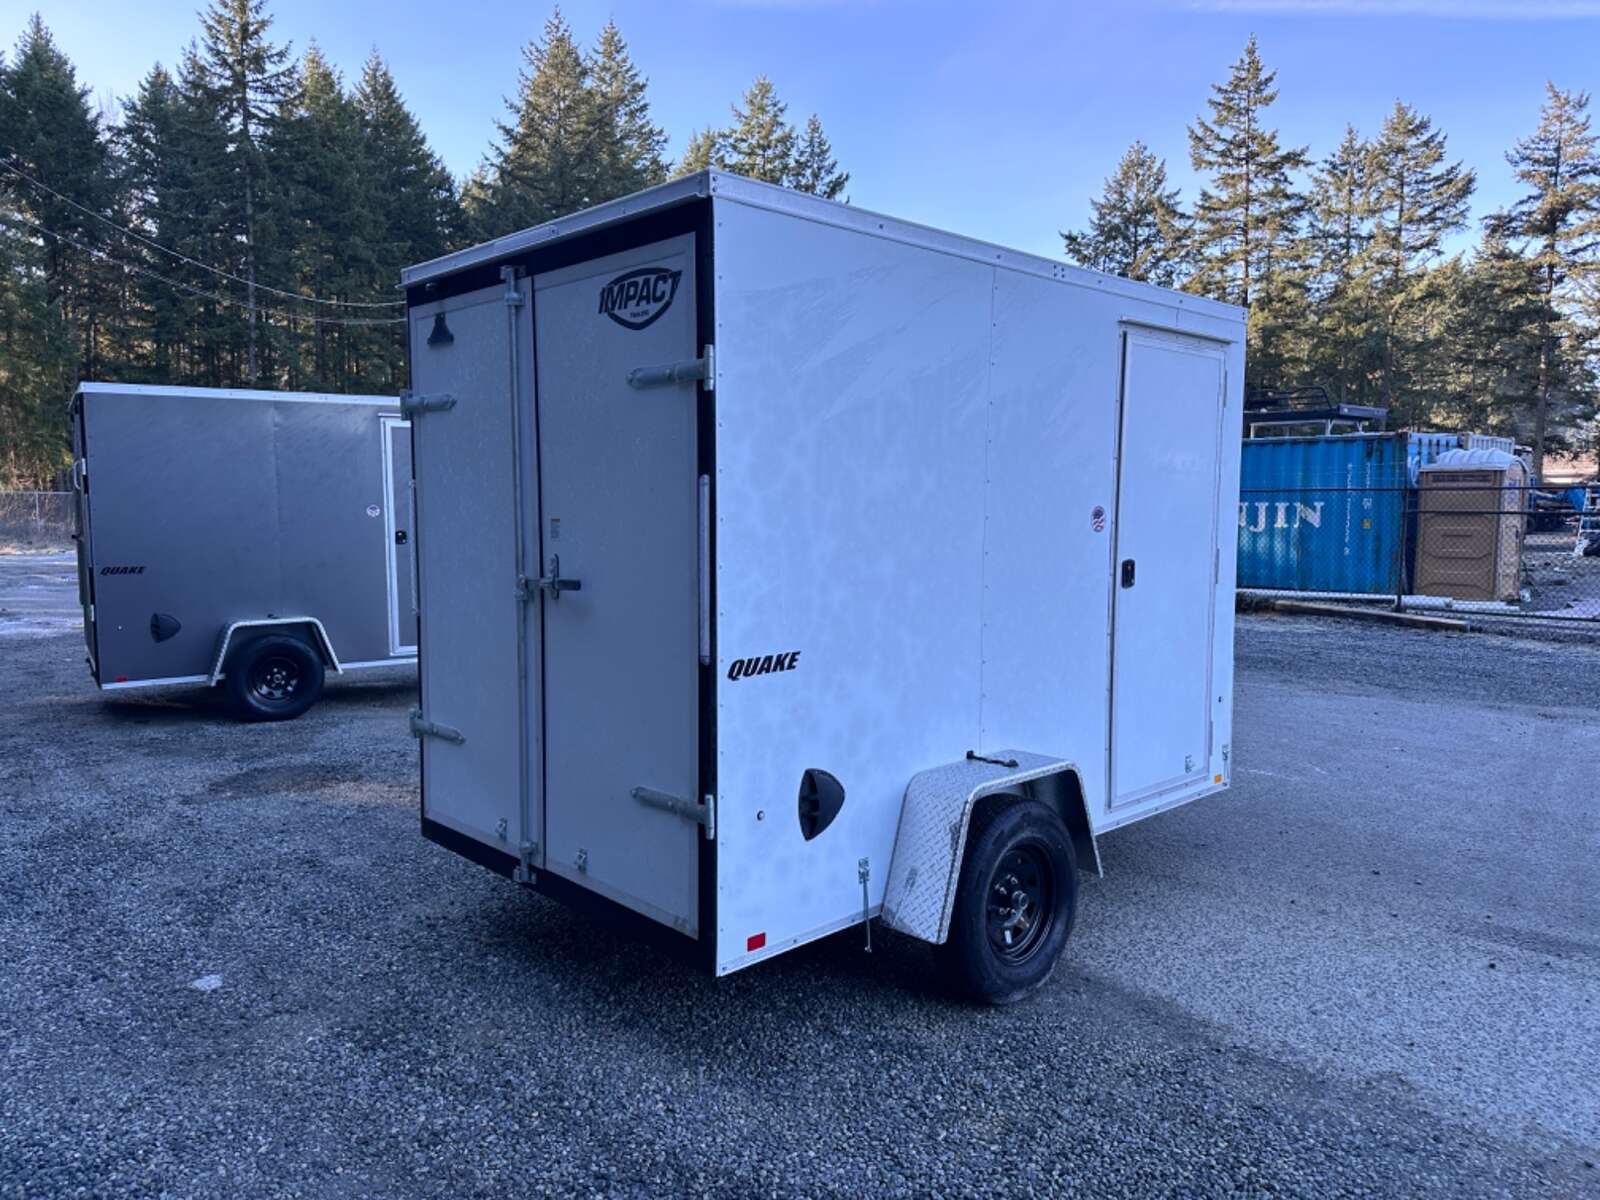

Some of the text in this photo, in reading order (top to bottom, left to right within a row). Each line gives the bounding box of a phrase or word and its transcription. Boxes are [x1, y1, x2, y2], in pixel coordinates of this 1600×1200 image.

[598, 270, 682, 314] IMPACT
[100, 566, 146, 576] QUAKE
[727, 651, 801, 681] QUAKE
